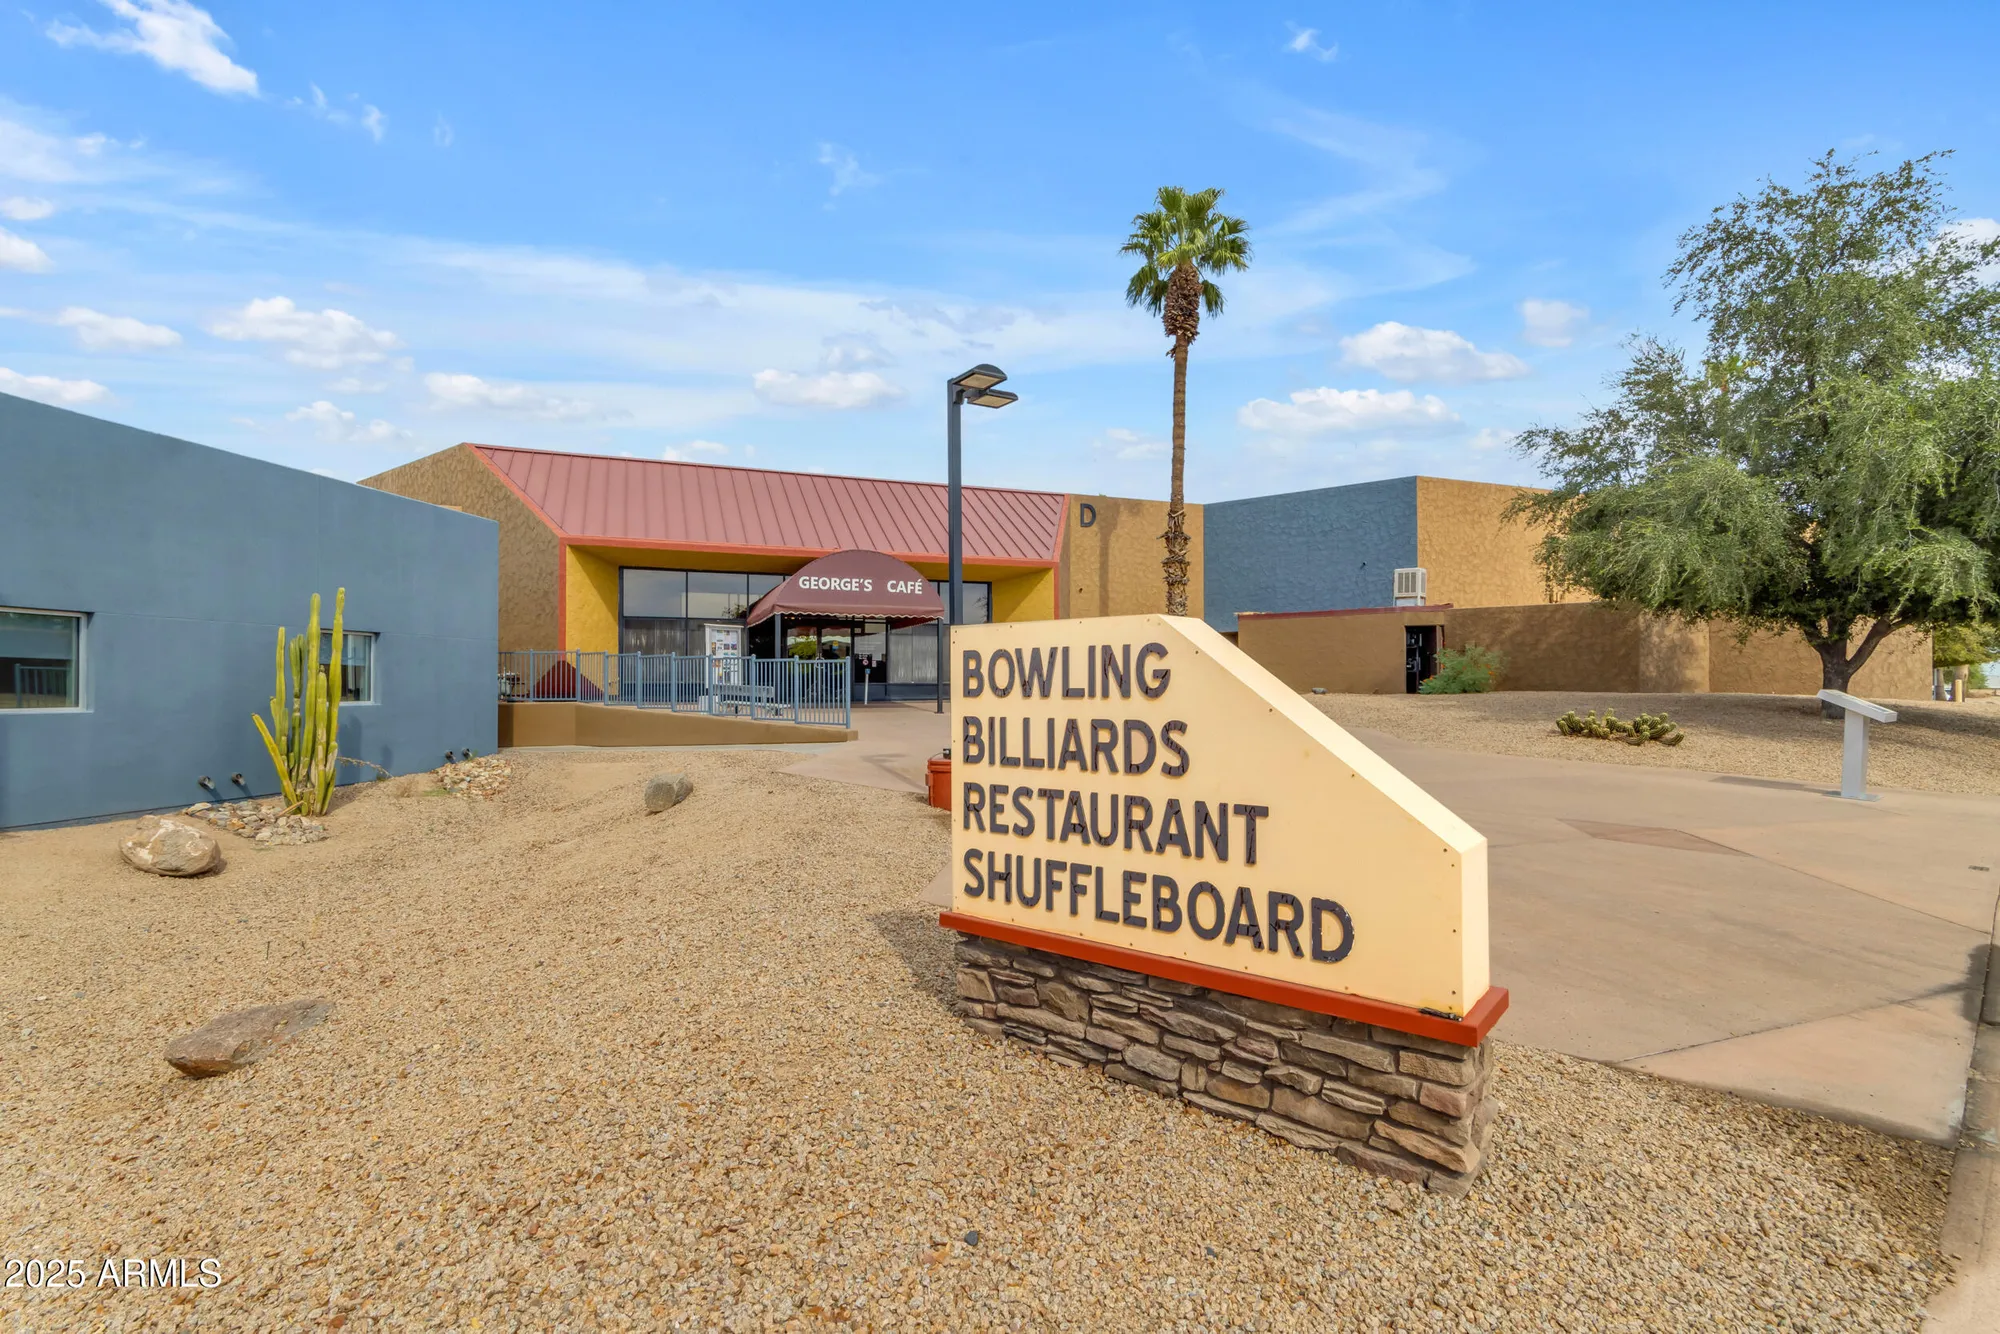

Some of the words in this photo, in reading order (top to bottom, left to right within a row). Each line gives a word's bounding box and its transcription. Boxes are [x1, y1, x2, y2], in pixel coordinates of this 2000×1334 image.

[1080, 503, 1096, 527] D
[799, 576, 873, 592] GEORGE'S
[887, 579, 923, 594] CAFÉ
[963, 642, 1171, 699] BOWLING
[962, 716, 1190, 777] BILLIARDS
[963, 782, 1269, 865] RESTAURANT
[963, 848, 1355, 964] SHUFFLEBOARD
